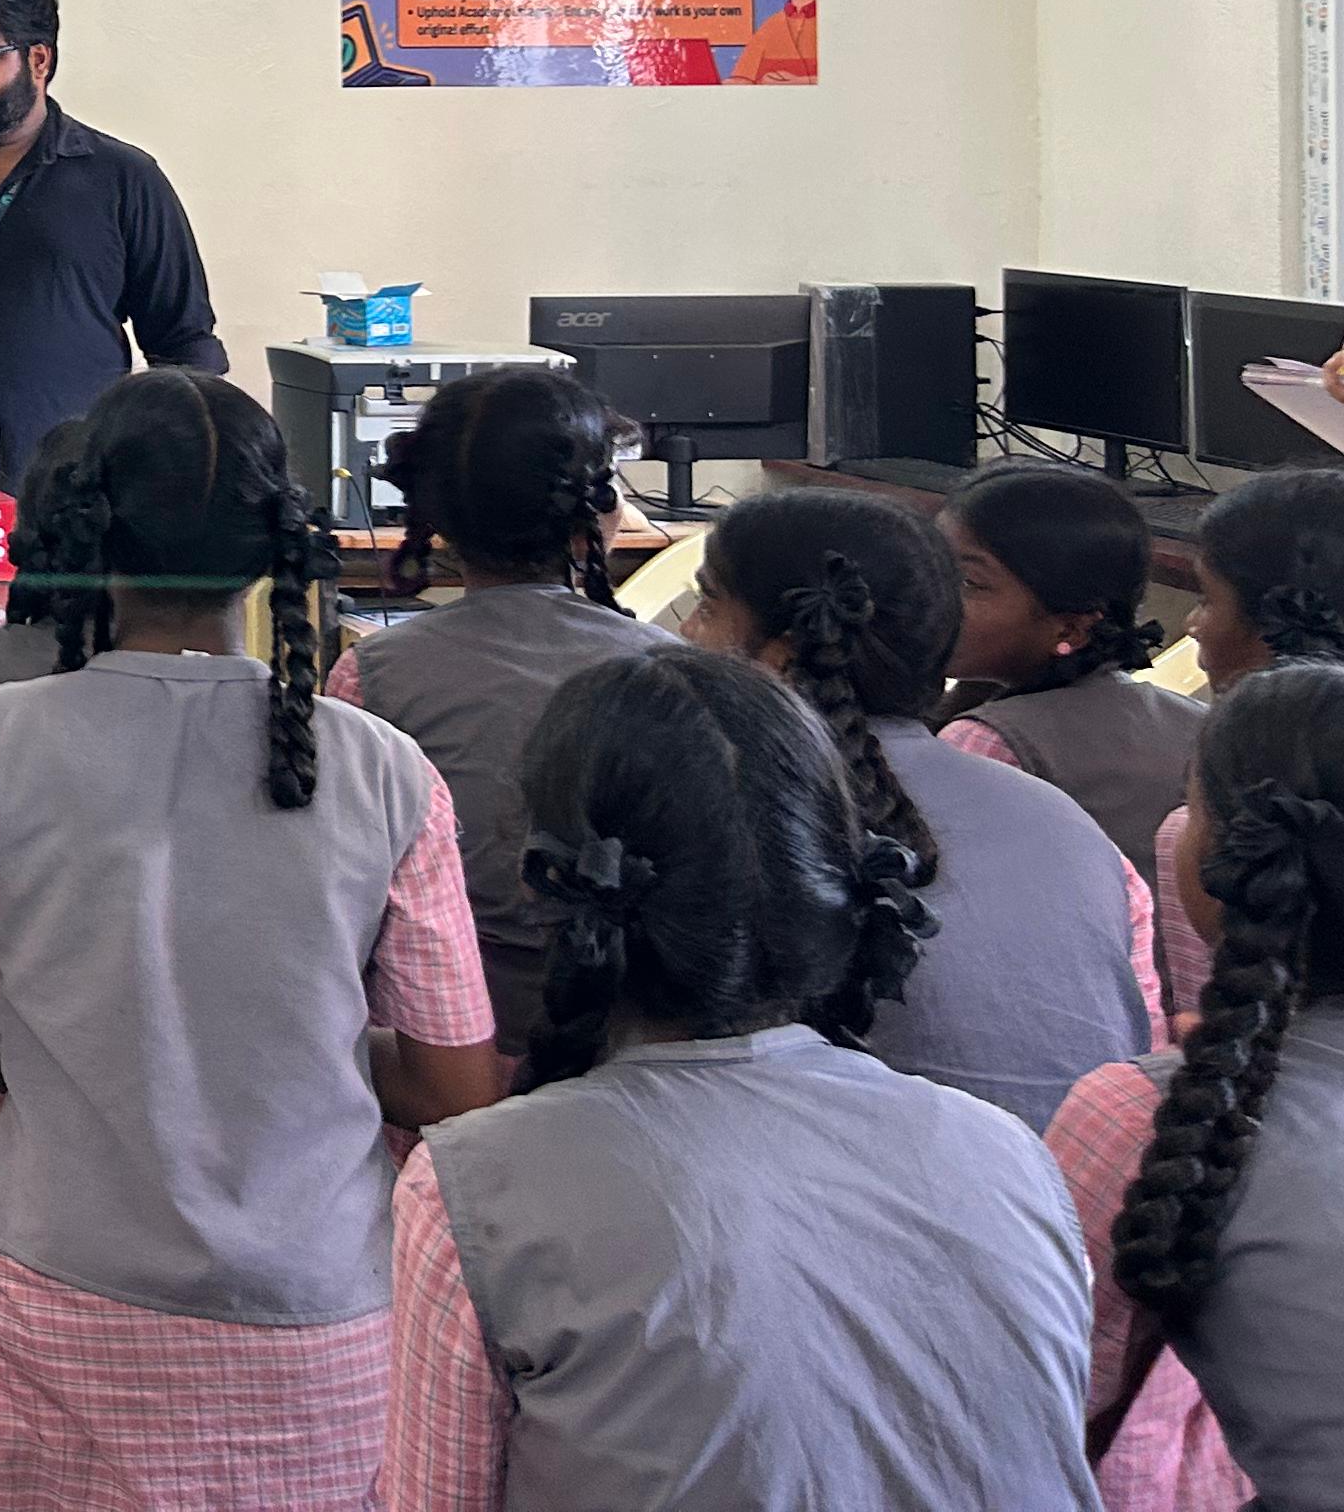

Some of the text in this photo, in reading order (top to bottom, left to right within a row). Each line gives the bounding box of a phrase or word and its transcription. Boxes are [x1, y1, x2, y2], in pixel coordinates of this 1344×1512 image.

[416, 5, 456, 20] Uphold
[655, 4, 680, 17] work
[683, 4, 692, 17] is
[693, 7, 718, 20] your
[720, 7, 742, 17] own
[416, 23, 458, 39] original
[556, 311, 612, 328] acer
